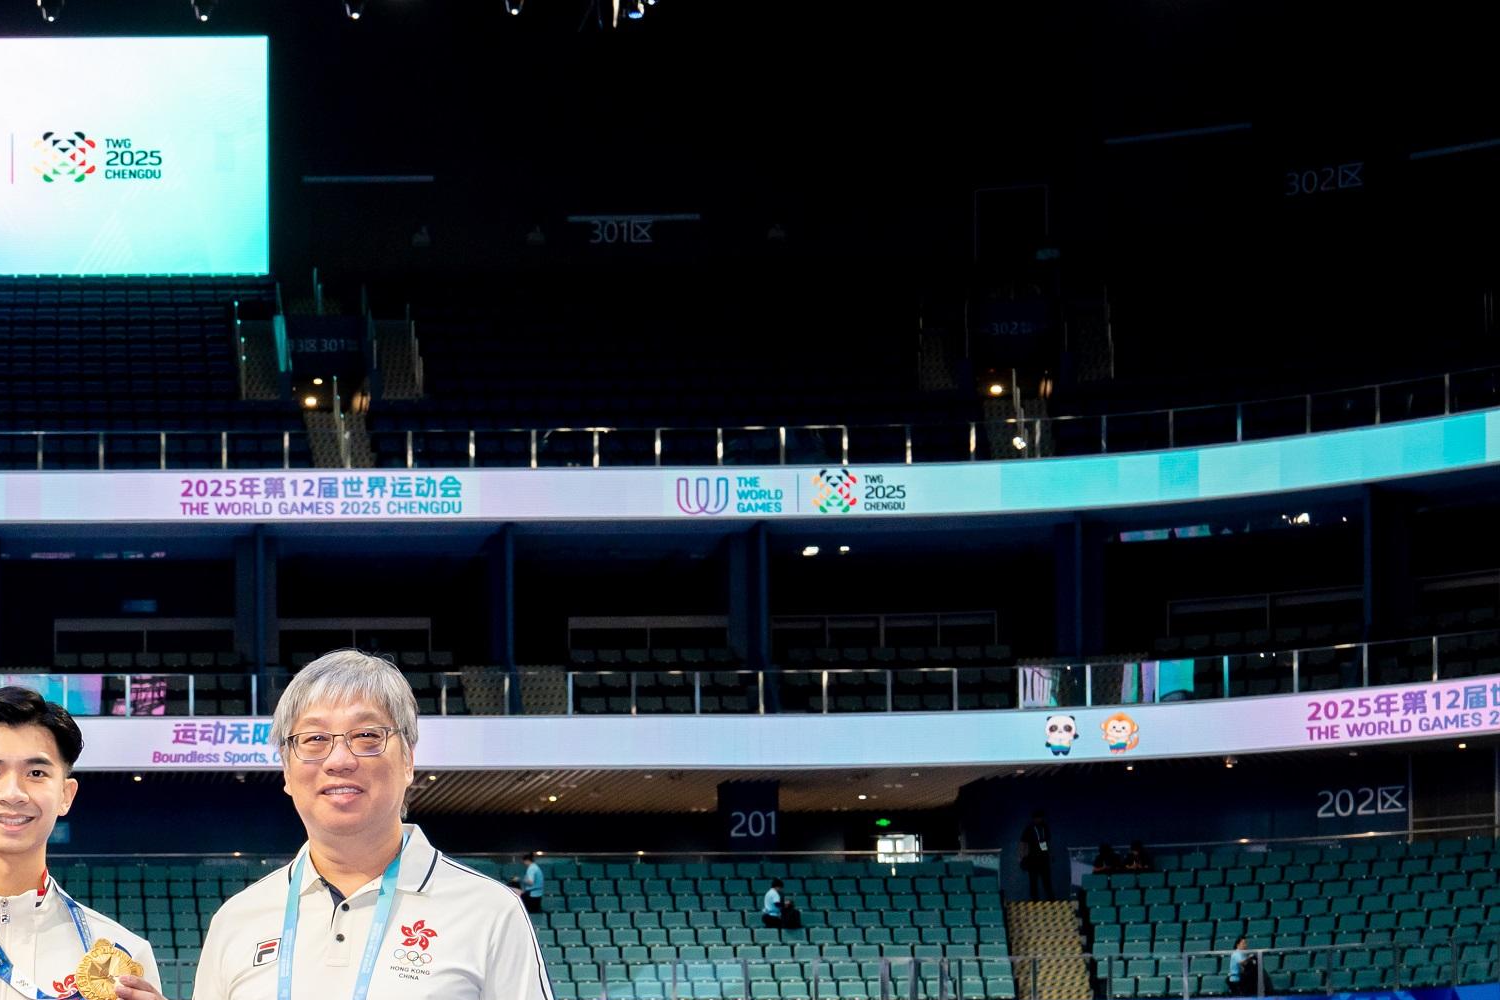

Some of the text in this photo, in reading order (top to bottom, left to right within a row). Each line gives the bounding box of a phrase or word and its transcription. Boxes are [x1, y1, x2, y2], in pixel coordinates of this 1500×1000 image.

[105, 139, 131, 149] TWG
[106, 150, 163, 167] 2025
[105, 168, 162, 180] CHENGDU
[1285, 162, 1364, 196] 302区
[589, 220, 653, 244] 301区
[737, 477, 760, 487] THE
[864, 475, 883, 484] TWG
[181, 475, 462, 499] 2025年第12届世界运动会
[865, 485, 906, 499] 2025
[737, 489, 783, 500] WORLD
[181, 500, 462, 515] THE WORLD GAMES 2025 CHENGDU
[737, 502, 782, 513] GAMES
[864, 501, 905, 511] CHENGDU
[1306, 725, 1340, 741] THE
[1347, 719, 1412, 737] WORLD
[1418, 711, 1482, 731] GAMES
[152, 750, 220, 763] Boundless
[223, 750, 269, 765] Sports,
[1316, 786, 1407, 818] 202区
[730, 810, 777, 838] 201
[390, 965, 430, 976] HONG KONG
